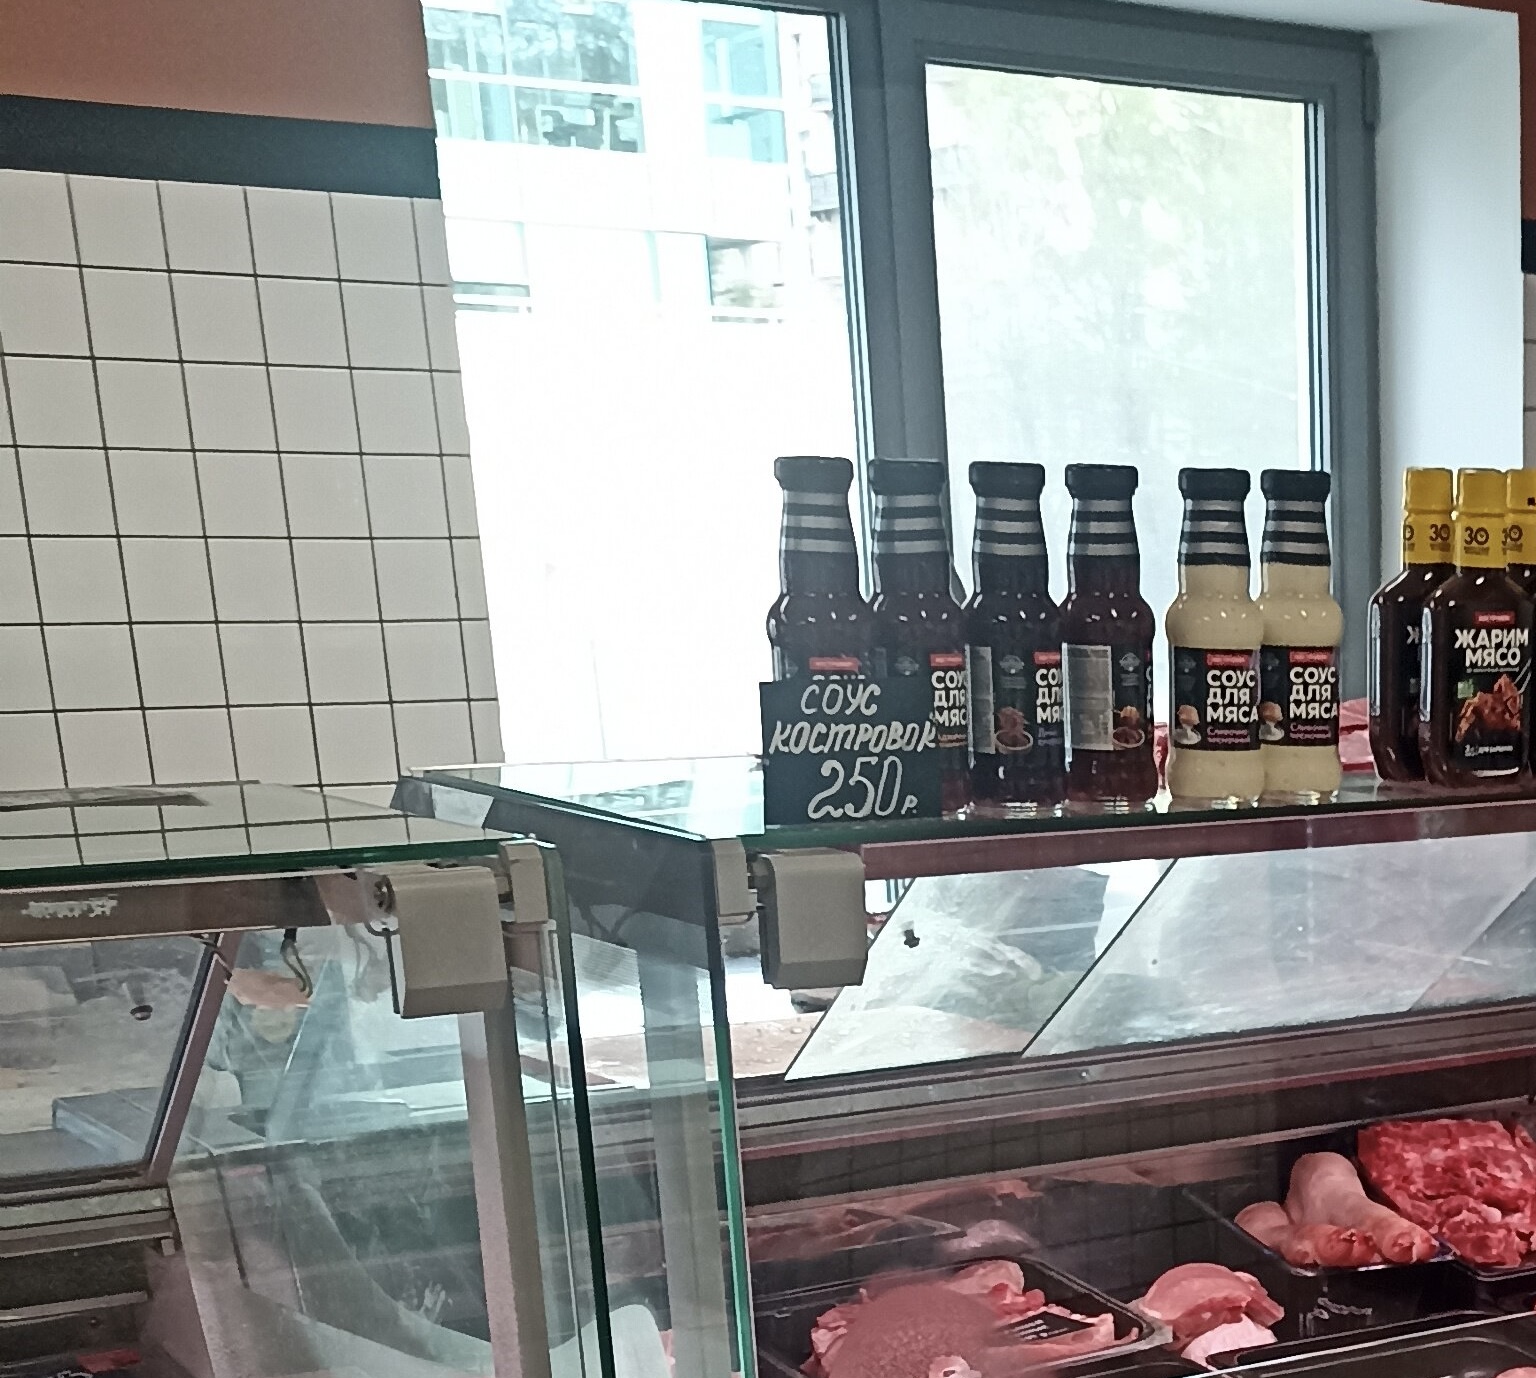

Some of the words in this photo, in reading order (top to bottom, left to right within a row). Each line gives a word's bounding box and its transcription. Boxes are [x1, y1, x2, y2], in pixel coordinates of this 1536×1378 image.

[1464, 527, 1489, 545] 30
[1454, 627, 1529, 650] ЖАРИМ
[1465, 647, 1521, 667] МЯСО
[931, 670, 968, 688] СОУ
[1206, 670, 1256, 688] СОУС
[1290, 667, 1337, 684] СОУС
[800, 683, 881, 715] СОУС
[1206, 688, 1250, 705] ДЛЯ
[1289, 685, 1332, 702] ДЛЯ
[934, 708, 967, 727] МЯС
[1206, 706, 1259, 724] МЯСА
[1289, 702, 1338, 720] МЯСА
[768, 720, 936, 754] КОСТРОВОК
